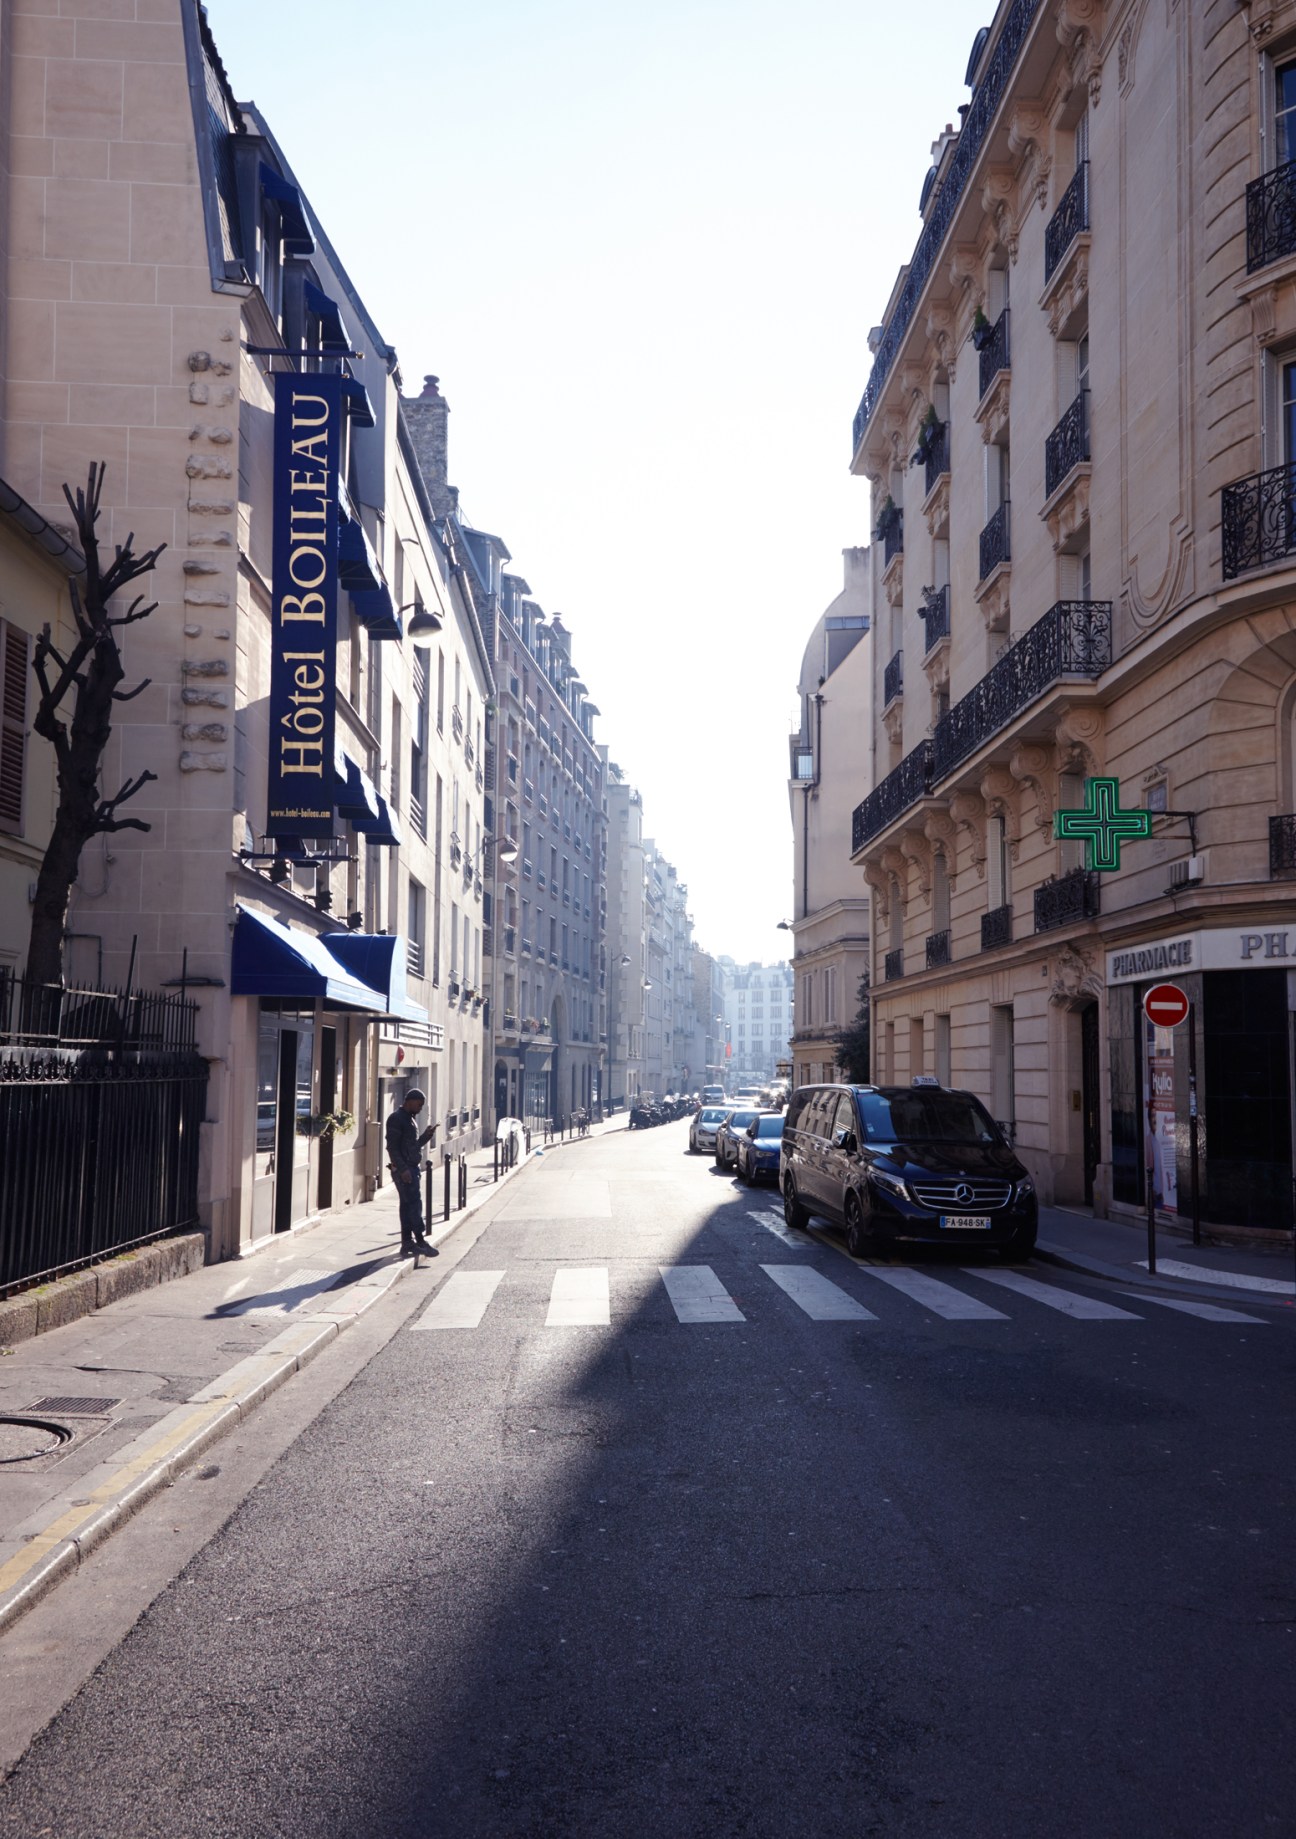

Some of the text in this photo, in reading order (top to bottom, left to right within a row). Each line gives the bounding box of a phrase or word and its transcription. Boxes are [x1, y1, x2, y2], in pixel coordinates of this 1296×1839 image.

[280, 391, 333, 779] Hôtel BOILEAU
[1112, 939, 1193, 978] PHARMACIE
[1240, 932, 1296, 960] PH
